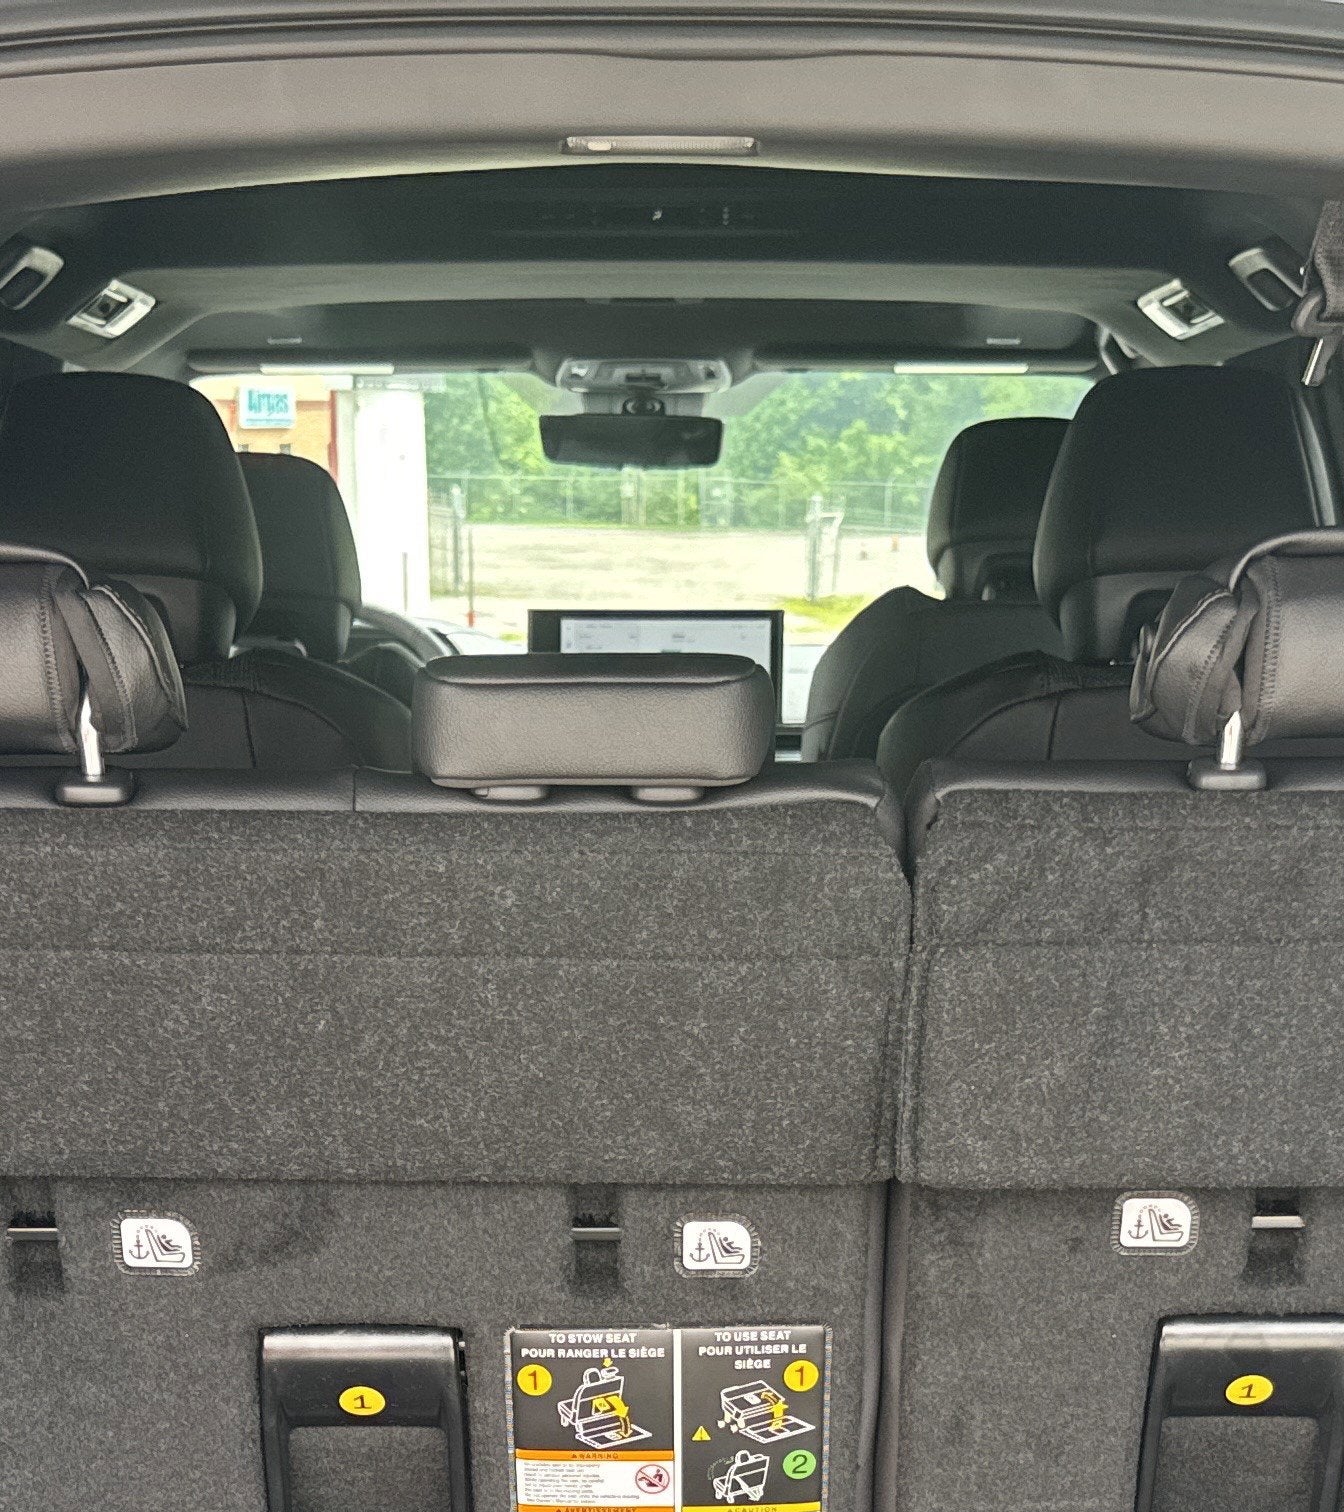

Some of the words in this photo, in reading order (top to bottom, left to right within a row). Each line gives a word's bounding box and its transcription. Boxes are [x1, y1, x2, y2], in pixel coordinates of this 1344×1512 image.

[549, 1333, 566, 1343] TO
[568, 1333, 604, 1343] STOW
[606, 1333, 637, 1343] SEAT
[714, 1332, 731, 1342] TO
[734, 1331, 758, 1341] USE
[760, 1331, 791, 1341] SEAT
[521, 1348, 555, 1358] POUR
[557, 1348, 609, 1358] RANGER
[611, 1348, 627, 1358] LE
[629, 1346, 665, 1358] SIÈGE
[698, 1346, 733, 1356] POUR
[735, 1344, 789, 1355] UTILISER
[791, 1343, 807, 1354] LE
[734, 1358, 772, 1370] SIÈGE
[527, 1370, 538, 1390] 1
[795, 1365, 805, 1386] 1
[1239, 1383, 1257, 1399] 1
[353, 1394, 372, 1409] 1
[791, 1454, 808, 1475] 2
